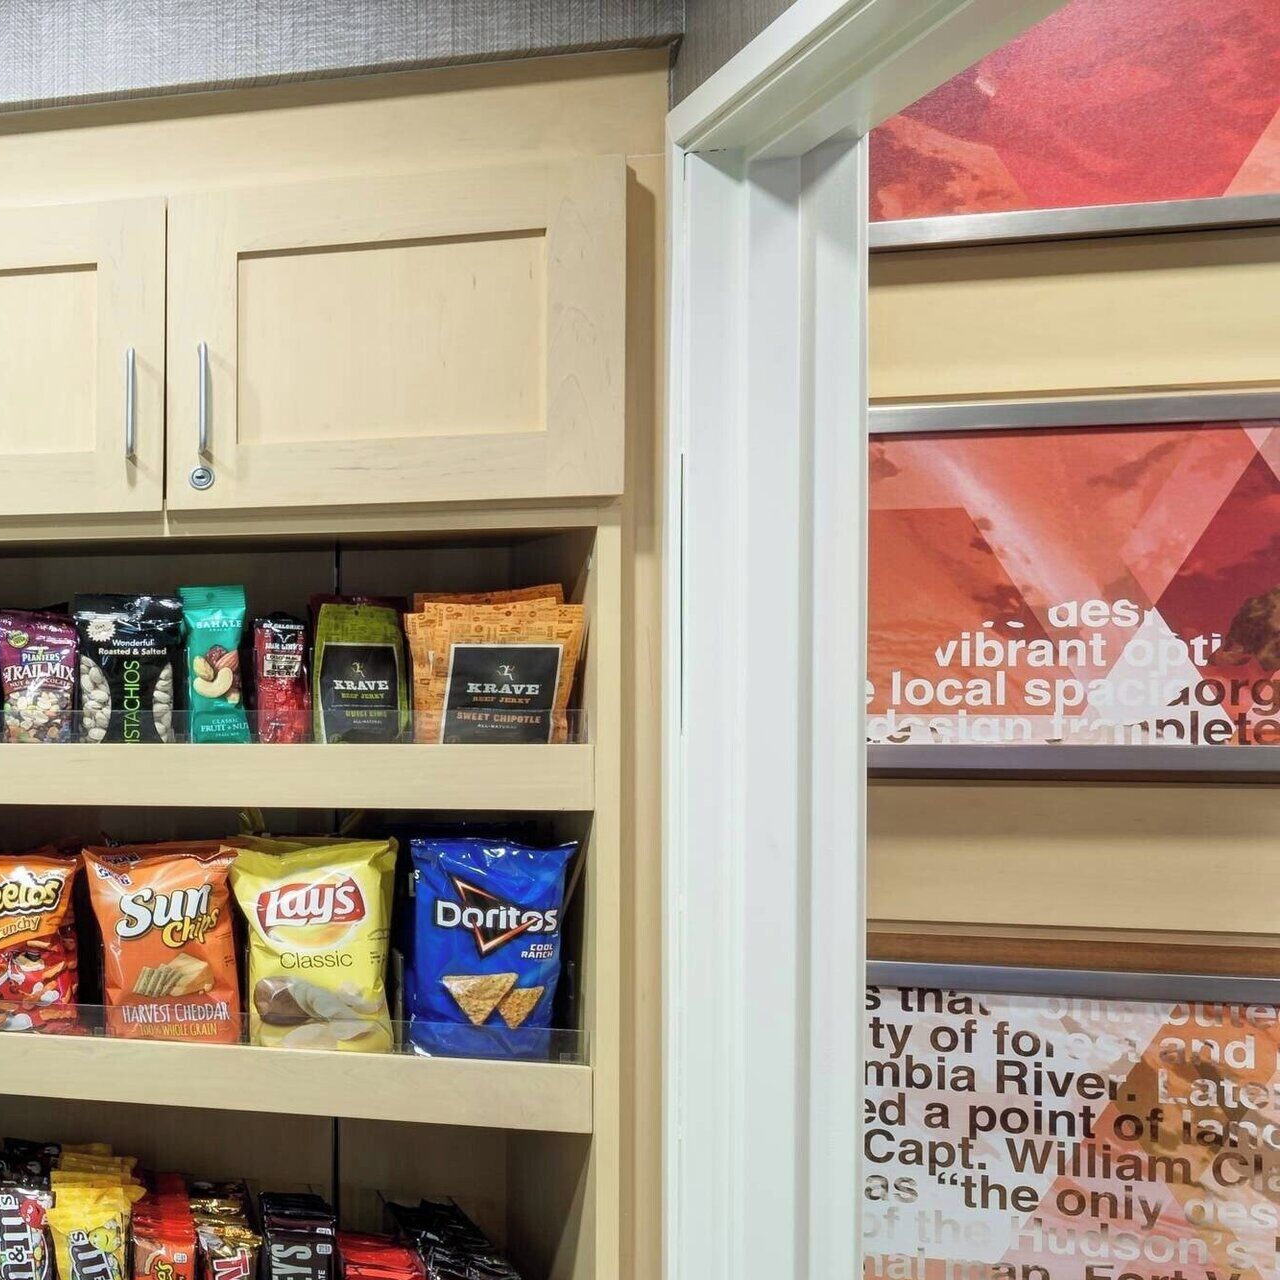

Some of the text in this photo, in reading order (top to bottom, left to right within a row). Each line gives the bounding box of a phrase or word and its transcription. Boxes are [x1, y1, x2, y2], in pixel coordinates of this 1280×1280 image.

[196, 619, 242, 629] SAHALE
[112, 637, 154, 648] Wonderful
[934, 632, 1107, 668] vibrant
[21, 652, 60, 663] PLANTERS
[98, 646, 167, 657] Roasted Salted
[6, 665, 75, 682] TRAIL MIX
[333, 679, 389, 692] KRAVE
[467, 682, 539, 696] KRAVE
[891, 670, 1006, 706] local
[341, 692, 385, 700] BEEF JERKY
[499, 696, 532, 704] JERKY
[457, 712, 541, 724] SWEET CHIPOTLE
[200, 724, 223, 733] FRUIT
[117, 882, 211, 940] Sun
[435, 899, 558, 932] Doritos
[162, 907, 219, 948] Chips
[521, 950, 553, 959] RANCH
[530, 943, 553, 951] COOL
[279, 950, 353, 970] Classic
[122, 1002, 229, 1022] HARVEST CHEDDAR
[163, 1024, 217, 1036] WHOLE GRAIN
[869, 1017, 1256, 1070] ty of and
[865, 1055, 1136, 1102] mbia River.
[924, 1101, 1163, 1142] a point of
[864, 1130, 1191, 1184] Capt. William
[1056, 1185, 1163, 1230] only
[915, 1211, 991, 1245] the
[1010, 1216, 1260, 1270] Hudson's
